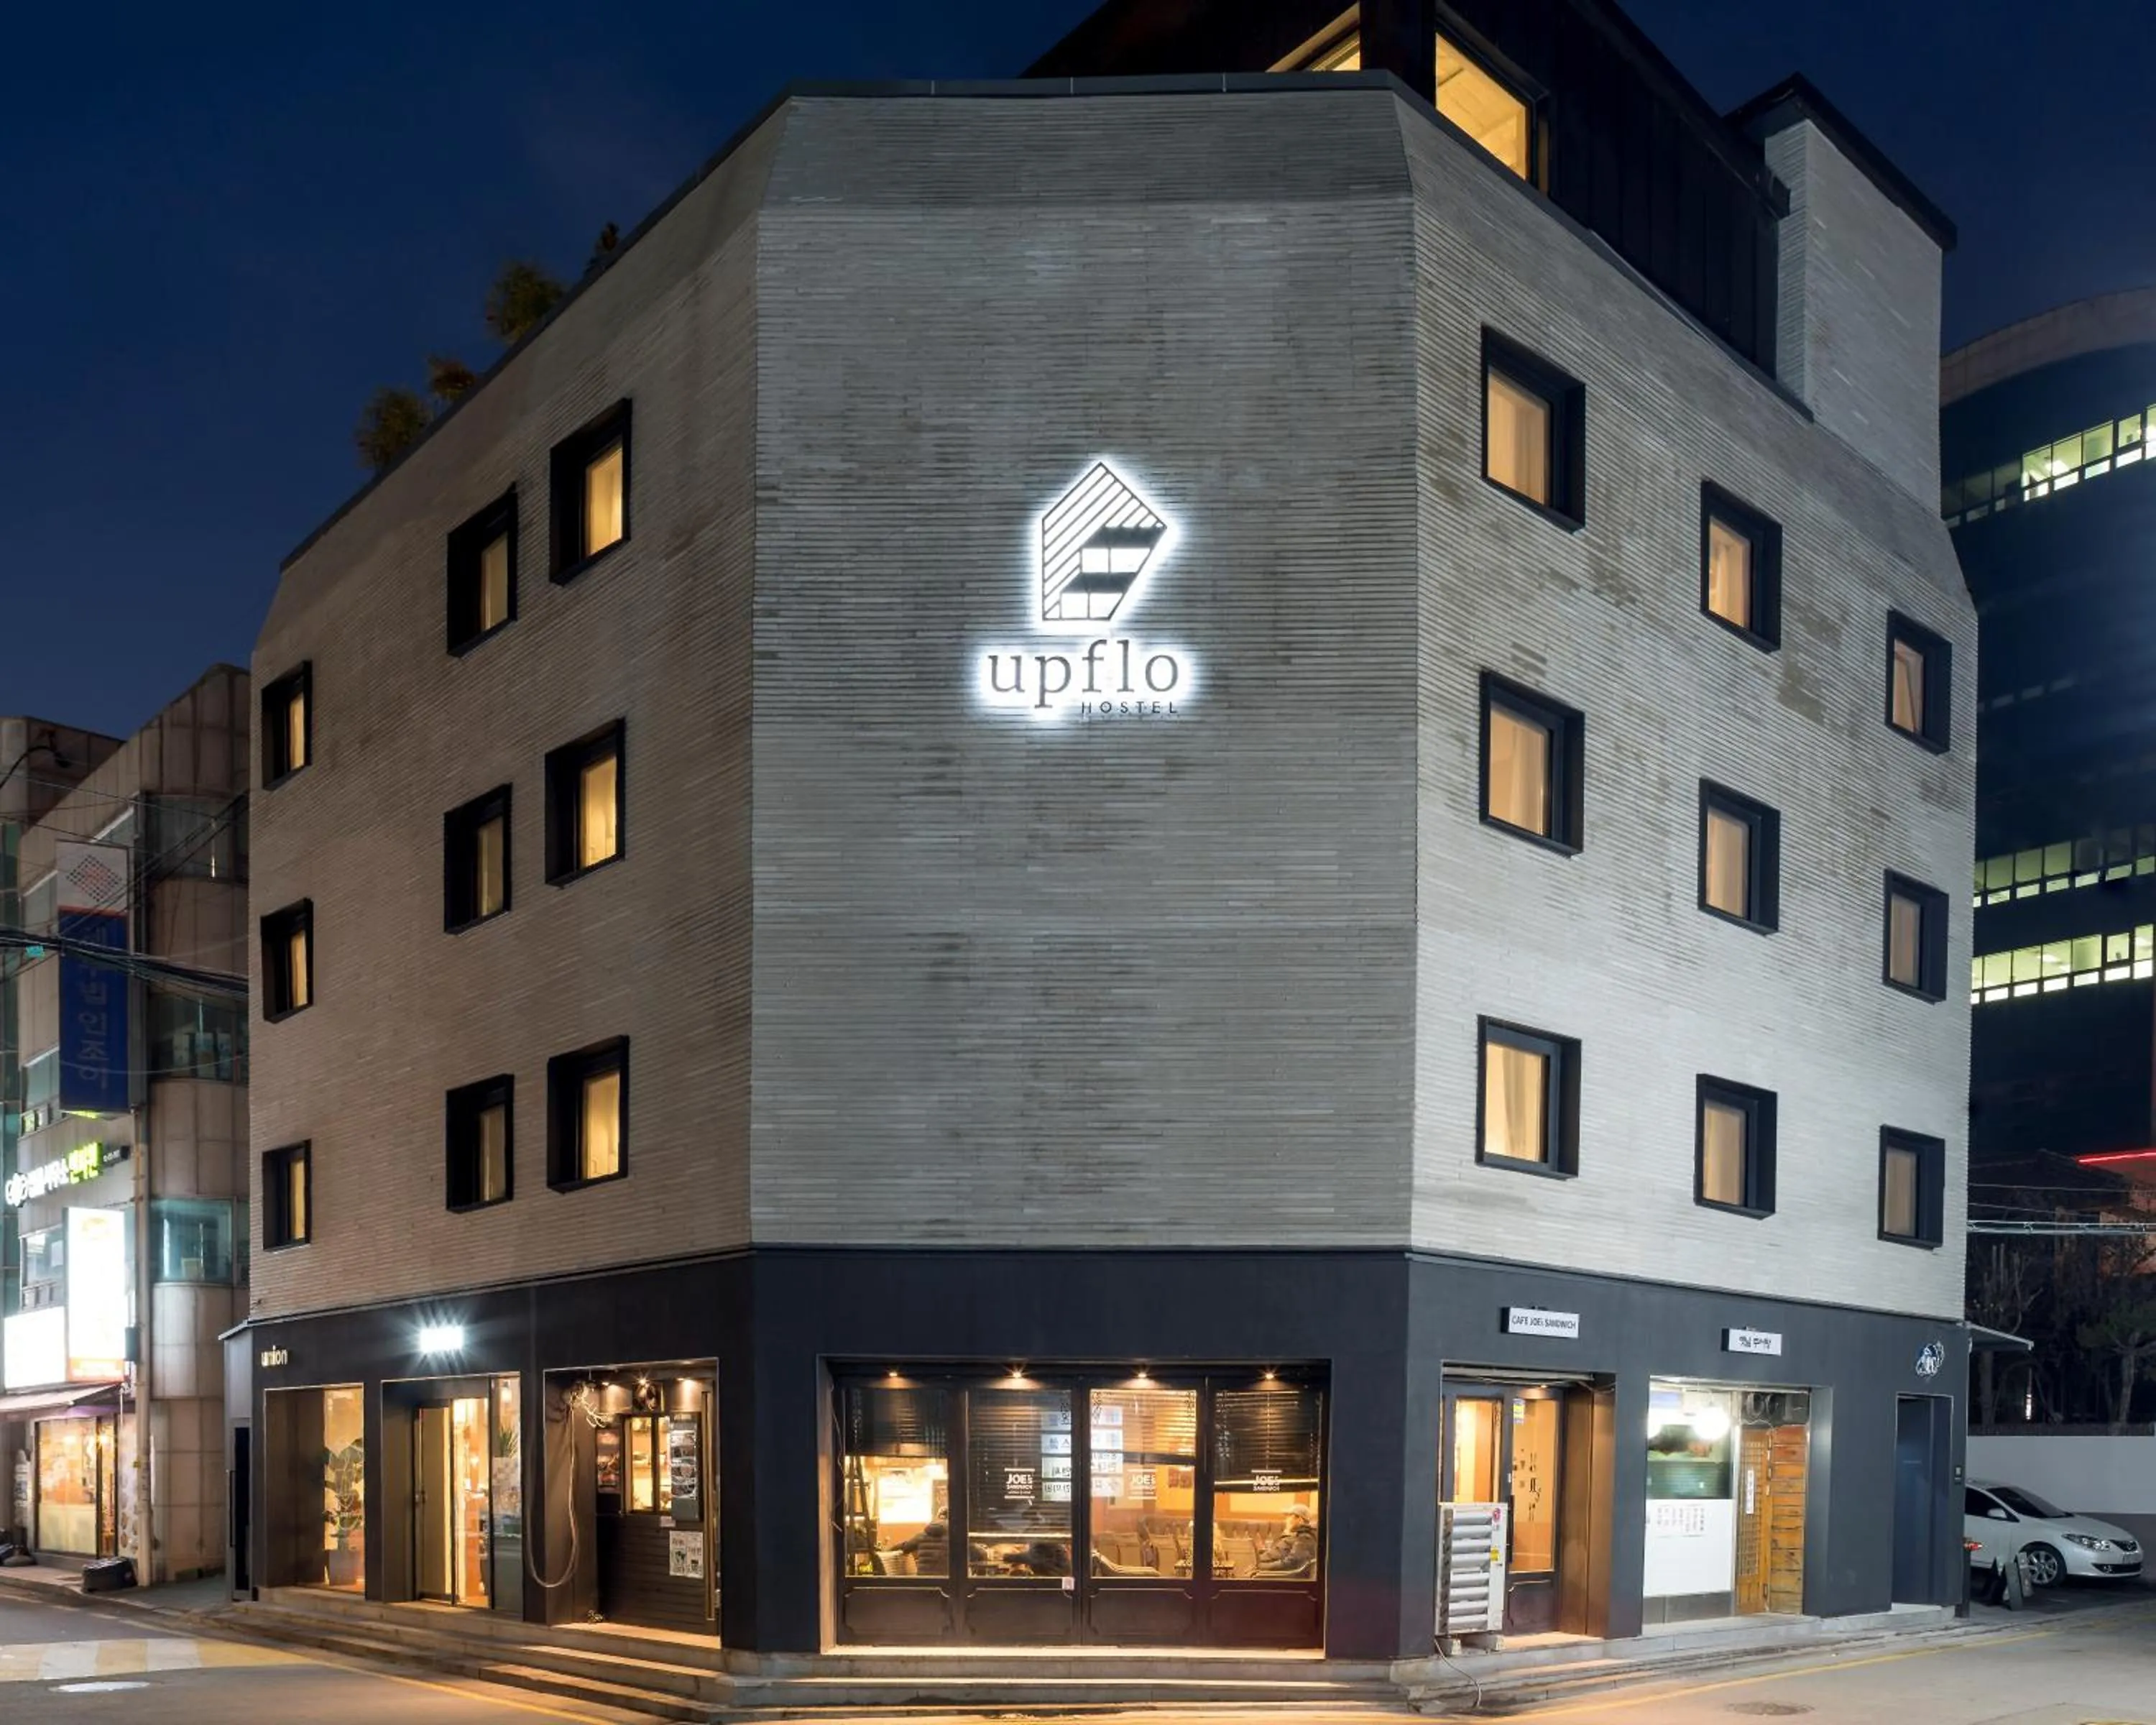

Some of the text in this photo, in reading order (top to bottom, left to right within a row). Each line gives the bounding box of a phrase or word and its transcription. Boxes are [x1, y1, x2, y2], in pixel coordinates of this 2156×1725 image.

[987, 639, 1179, 709] upflo
[1082, 701, 1177, 714] HOSTEL
[1511, 1314, 1528, 1325] CAFE
[261, 1345, 287, 1366] union
